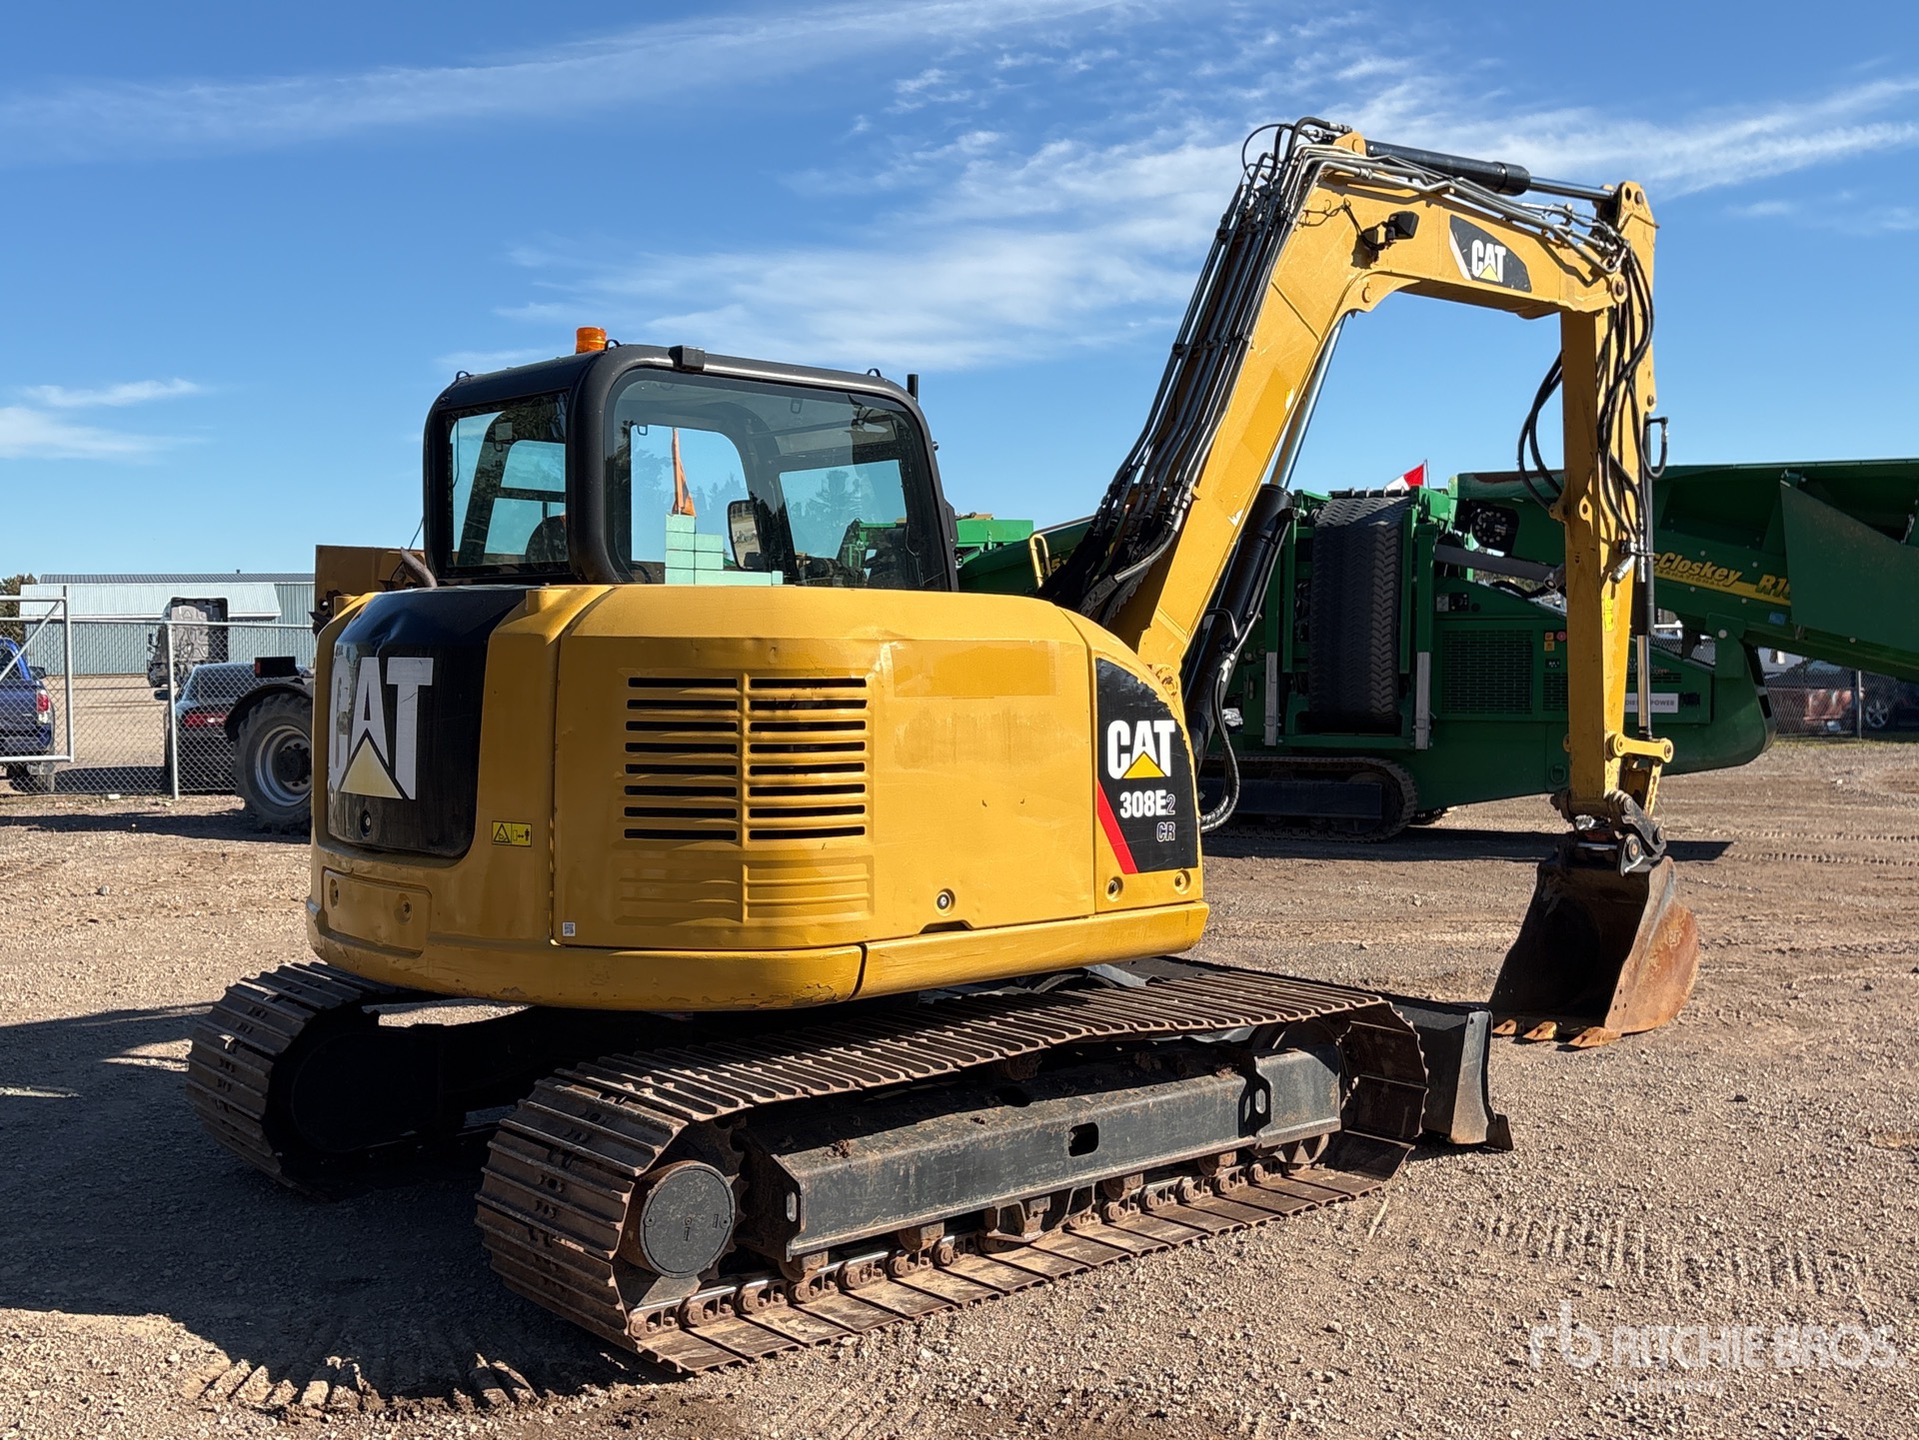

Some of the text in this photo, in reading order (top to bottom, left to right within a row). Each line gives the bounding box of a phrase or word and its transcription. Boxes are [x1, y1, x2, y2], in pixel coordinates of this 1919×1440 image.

[1471, 239, 1506, 283] CAT
[1653, 552, 1742, 588] cCloskey
[328, 656, 434, 801] CAT
[1107, 719, 1176, 780] CAT
[1156, 822, 1176, 842] CR
